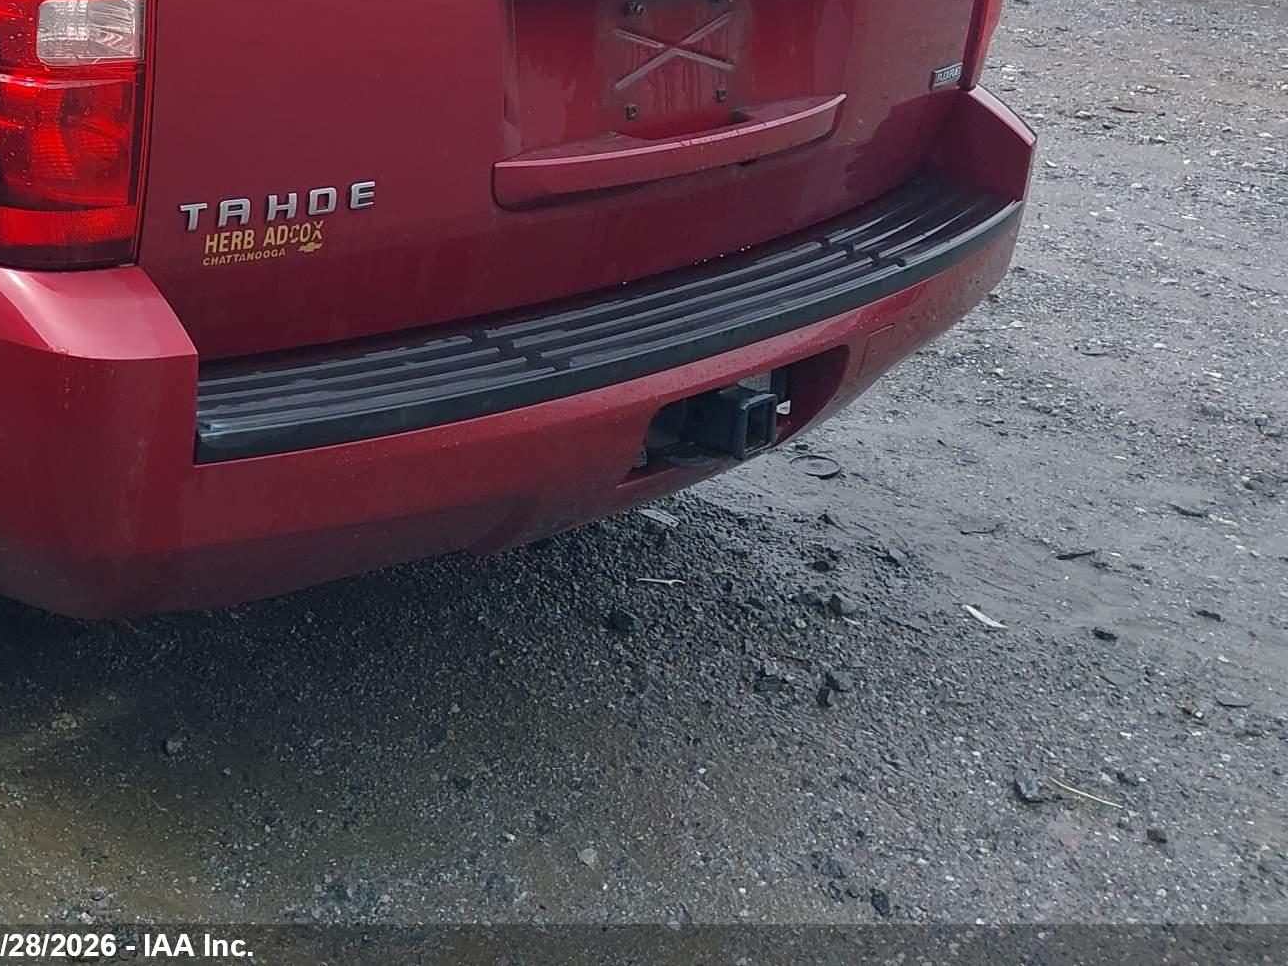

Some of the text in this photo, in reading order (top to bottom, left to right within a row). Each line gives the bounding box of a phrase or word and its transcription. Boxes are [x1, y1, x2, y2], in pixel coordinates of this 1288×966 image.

[179, 181, 376, 232] TAHOE
[204, 220, 325, 255] HERB ADCOX
[202, 248, 287, 266] CHATTANOOGA
